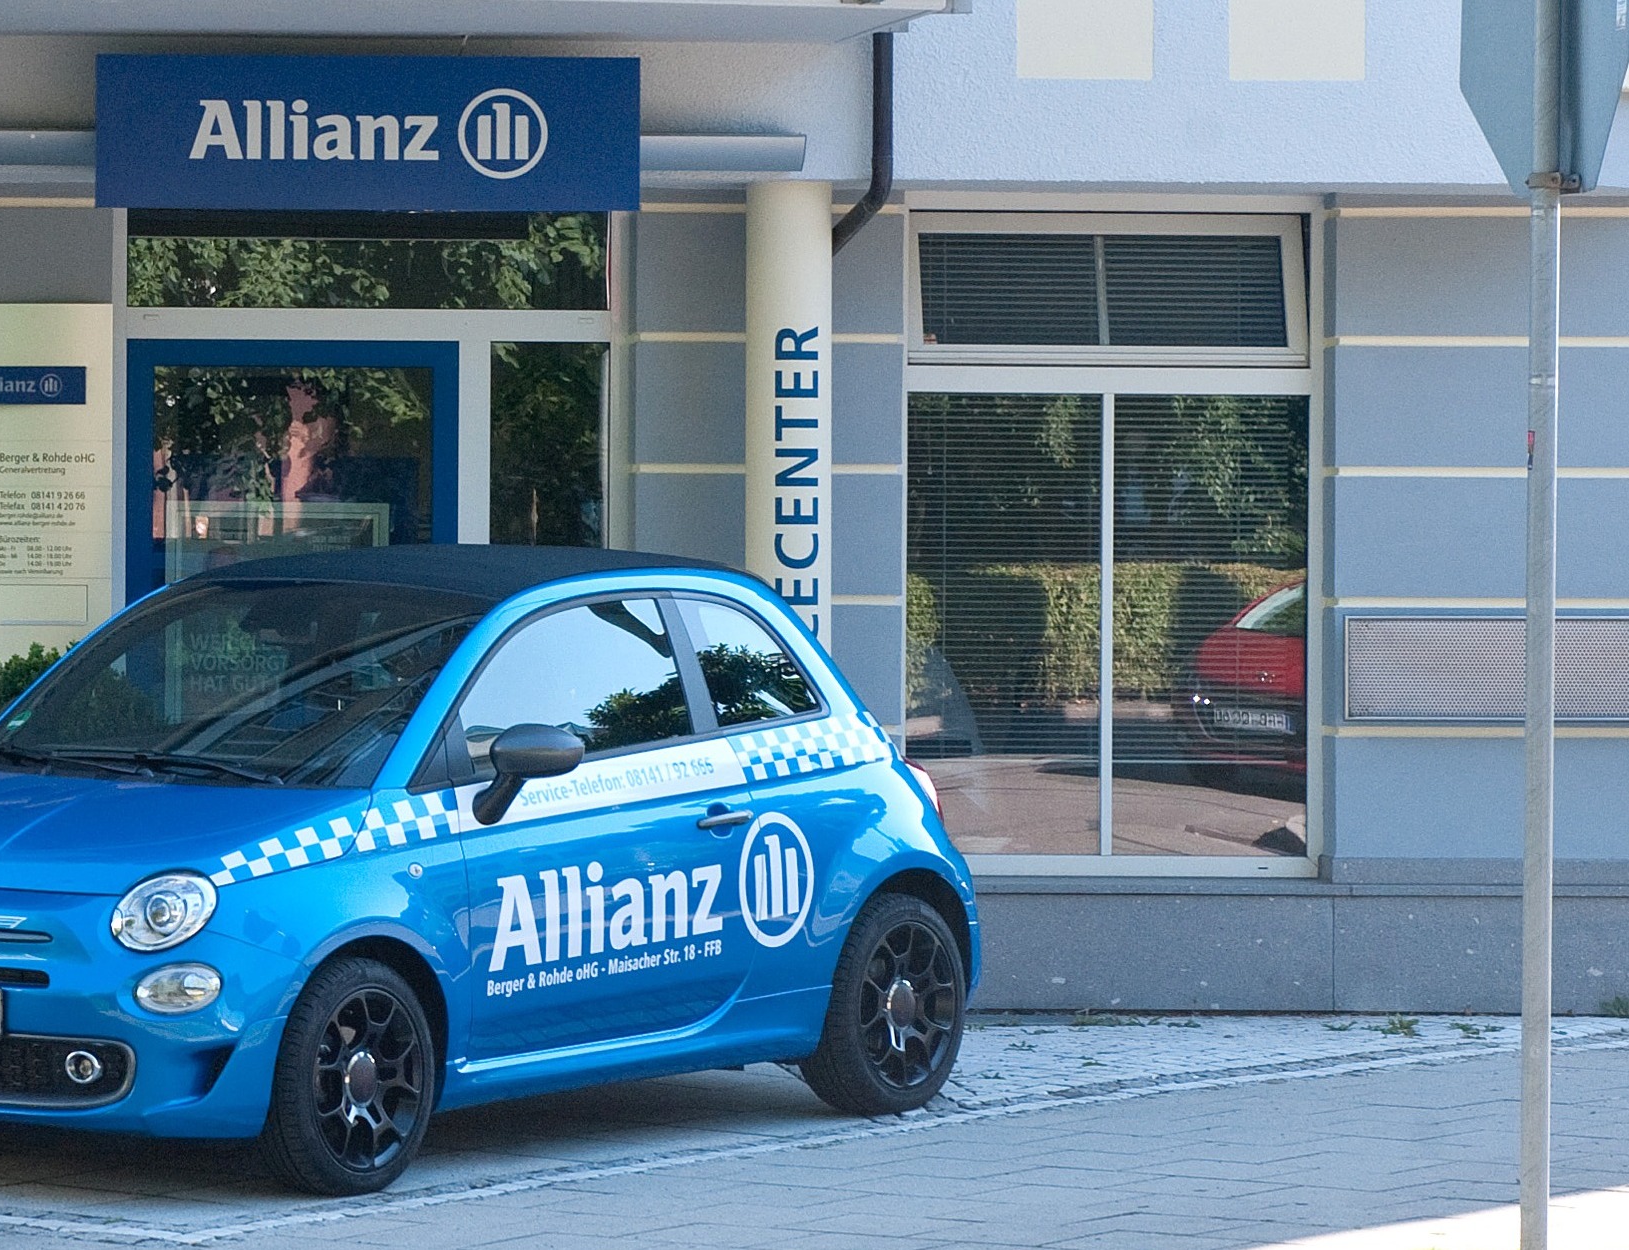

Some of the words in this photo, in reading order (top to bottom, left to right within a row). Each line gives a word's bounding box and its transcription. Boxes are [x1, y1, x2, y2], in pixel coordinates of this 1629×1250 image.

[188, 98, 439, 161] Allianz
[0, 452, 30, 465] Berger
[32, 452, 40, 463] &
[42, 452, 73, 463] Rohde
[74, 453, 95, 464] oHG
[774, 326, 819, 640] ECENTER
[0, 490, 27, 500] Telefon
[30, 491, 55, 500] 08141
[56, 491, 62, 500] 9
[63, 491, 74, 500] 26
[75, 491, 86, 500] 66
[0, 502, 25, 510] Telefax
[30, 502, 55, 511] 08141
[56, 502, 62, 511] 4
[63, 502, 74, 511] 20
[75, 502, 86, 511] 76
[520, 773, 625, 807] Service-Telefon:
[625, 765, 664, 789] 08141
[666, 763, 672, 781] /
[672, 761, 690, 779] 92
[690, 756, 715, 777] 666
[488, 860, 724, 972] Allianz
[486, 977, 525, 998] Berger
[527, 972, 536, 990] &
[538, 966, 574, 988] Rohde
[575, 961, 599, 981] oHG
[608, 951, 662, 976] Maisacher
[663, 948, 681, 965] Str.
[683, 943, 696, 961] 18
[704, 939, 722, 957] FFB
